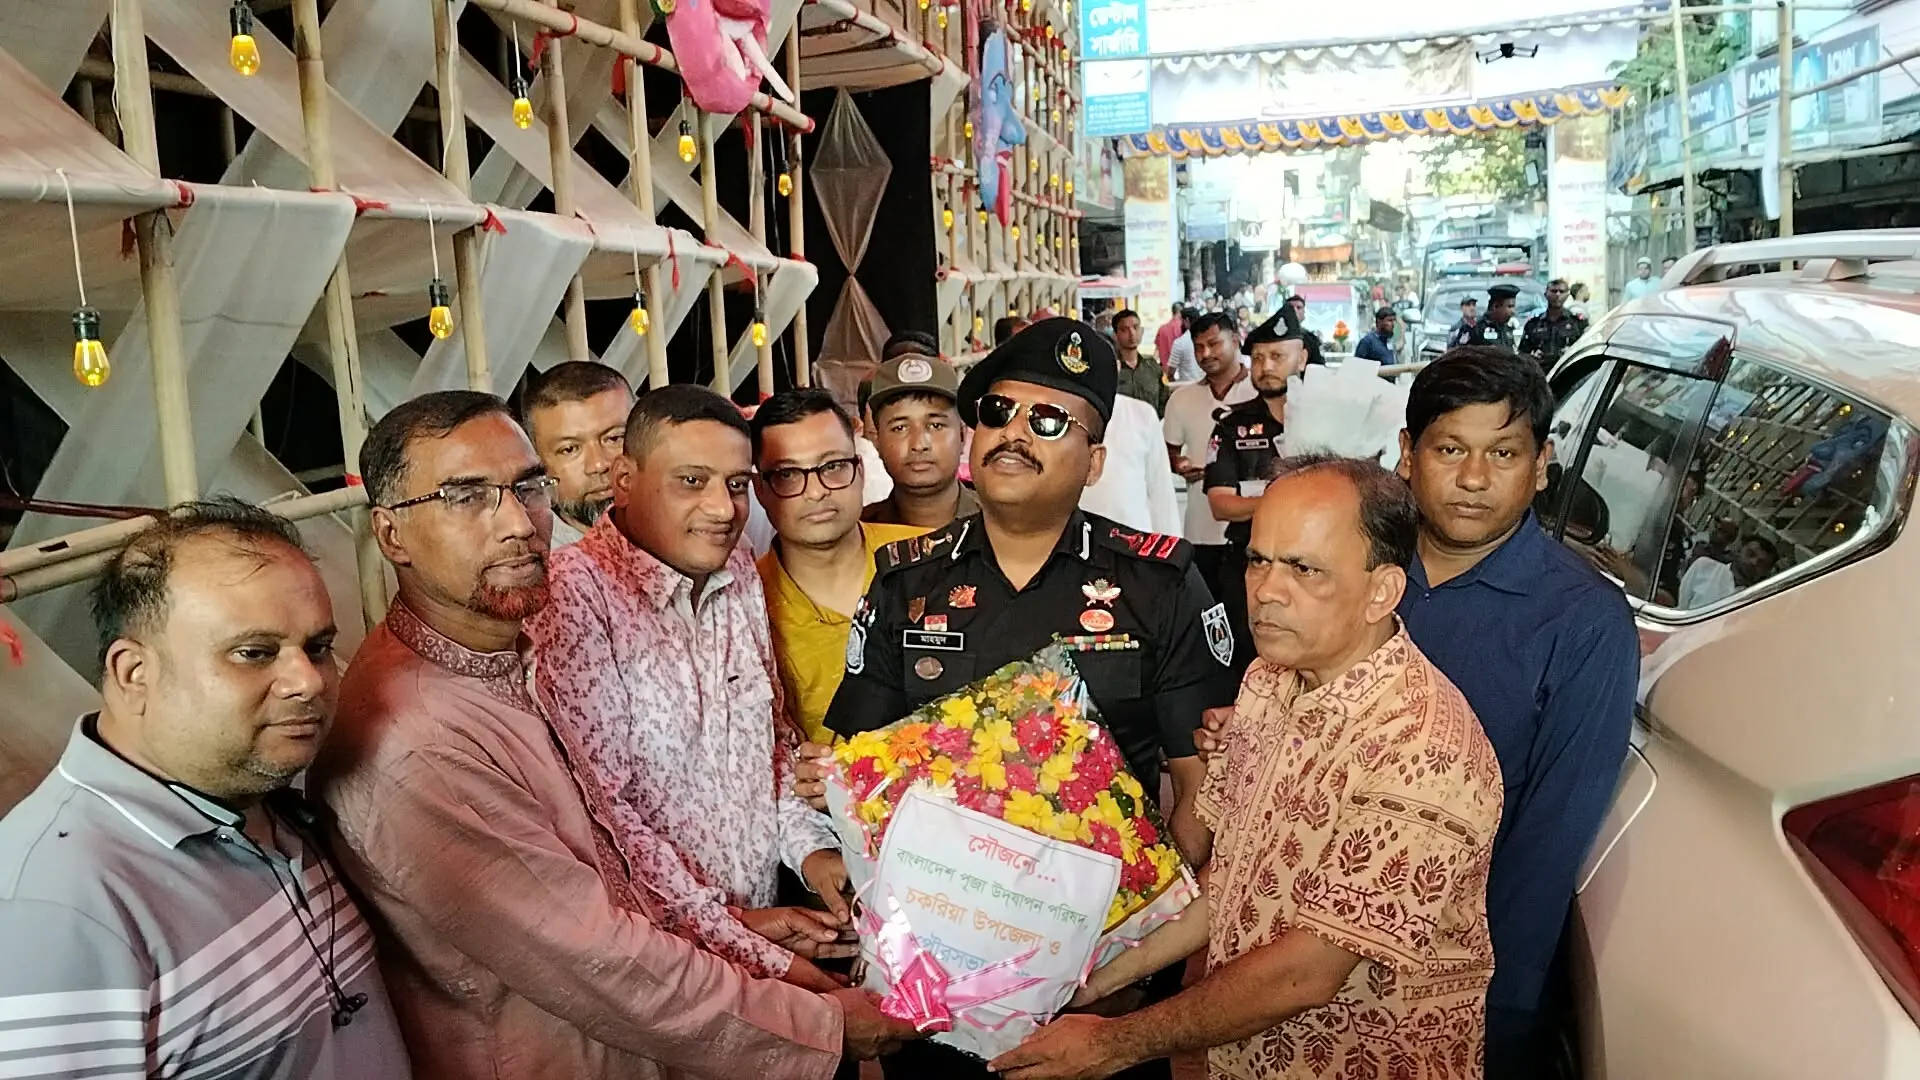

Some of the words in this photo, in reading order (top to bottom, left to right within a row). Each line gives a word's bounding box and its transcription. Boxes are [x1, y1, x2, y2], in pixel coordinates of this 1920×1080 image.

[896, 848, 957, 881] বাংলাদেশ
[959, 872, 988, 894] পূজা
[905, 886, 968, 926] চকরিয়া
[973, 907, 1045, 950] উপজেলা
[1049, 940, 1061, 956] ও
